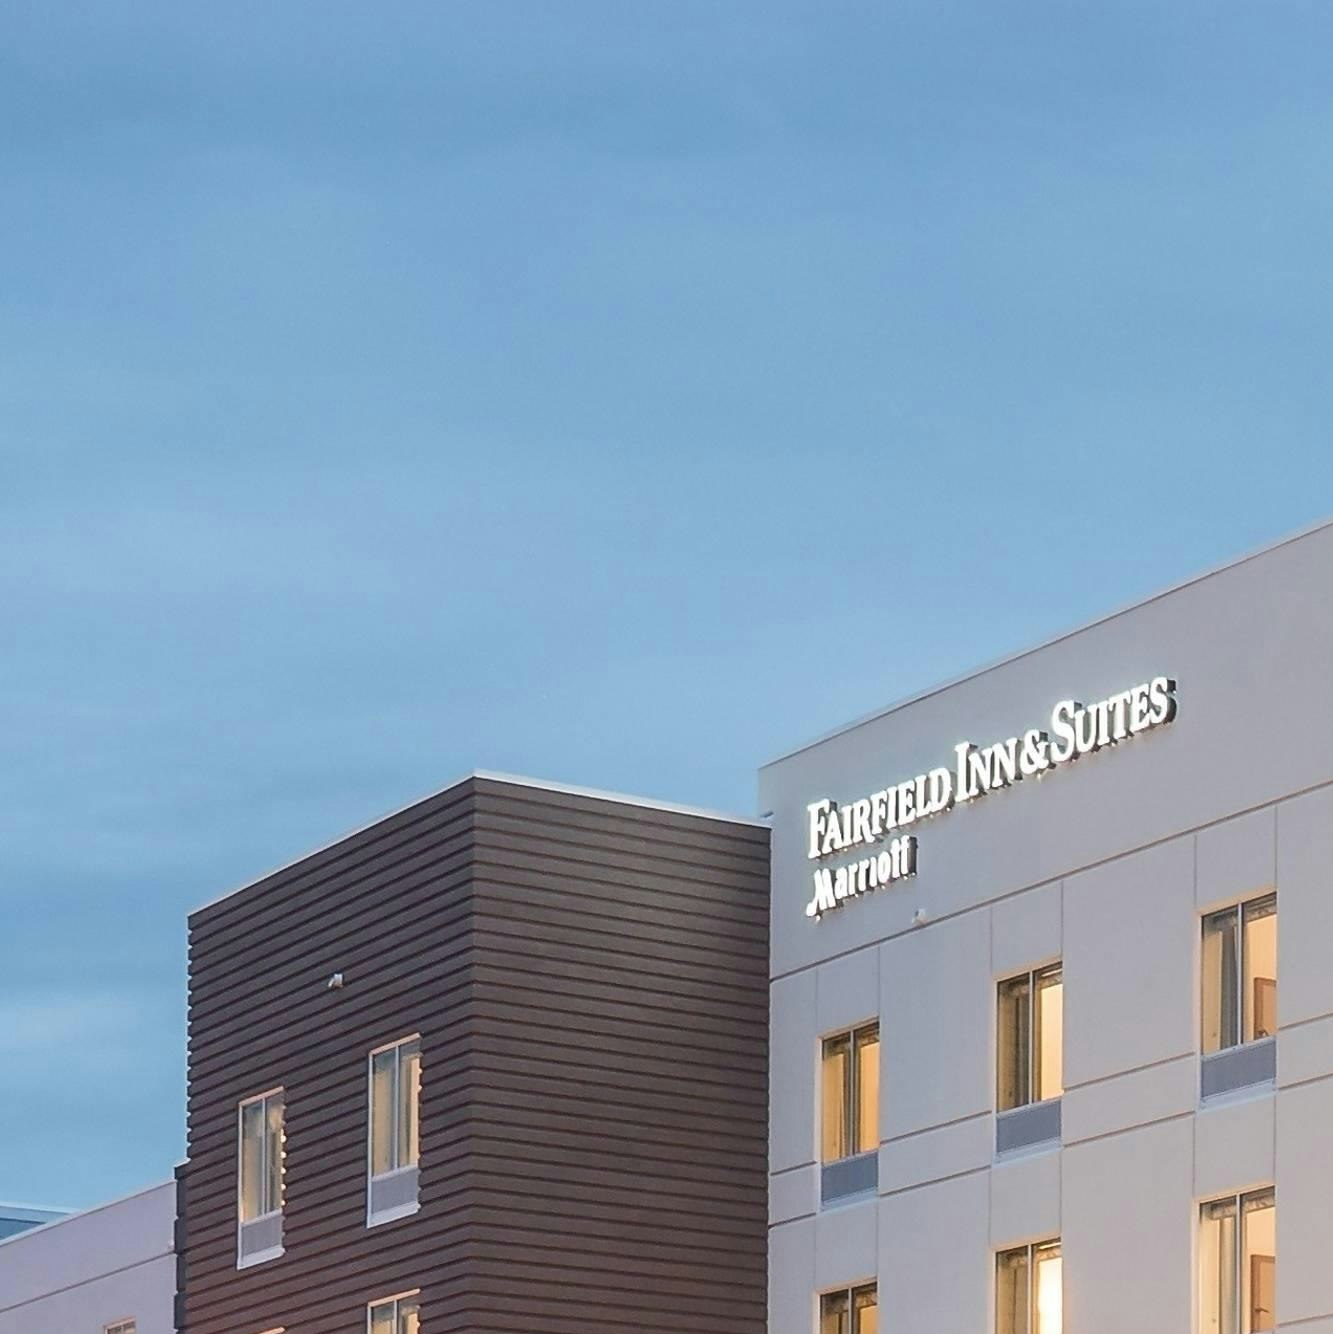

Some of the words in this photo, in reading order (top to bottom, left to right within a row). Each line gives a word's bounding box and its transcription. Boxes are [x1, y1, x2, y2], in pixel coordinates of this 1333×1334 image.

[806, 767, 953, 860] FAIRFIELD
[953, 737, 1019, 804] INN
[1050, 676, 1173, 763] SUITES
[805, 834, 914, 918] Marriott
